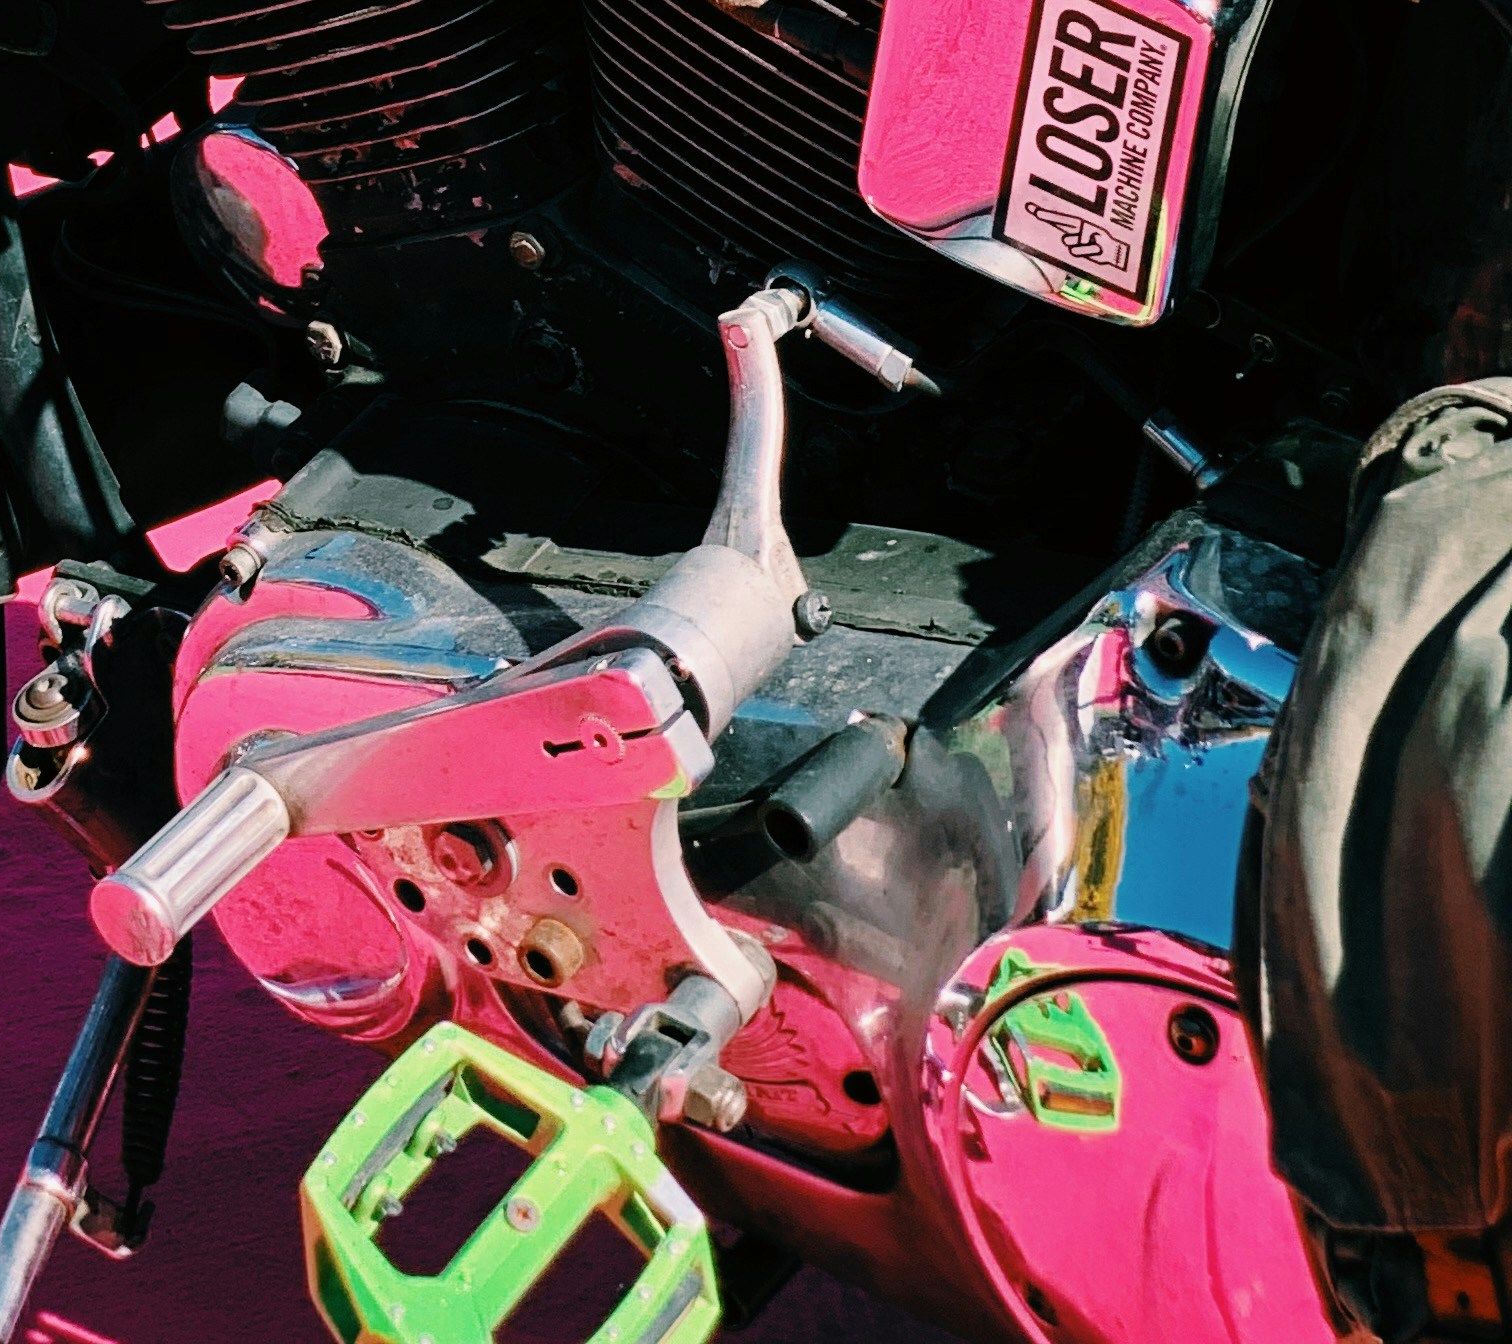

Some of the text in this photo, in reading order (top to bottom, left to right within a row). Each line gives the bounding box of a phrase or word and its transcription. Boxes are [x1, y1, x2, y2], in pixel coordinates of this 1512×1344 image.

[1029, 9, 1136, 216] LOSER
[1110, 39, 1166, 231] MACHINE COMPANY
